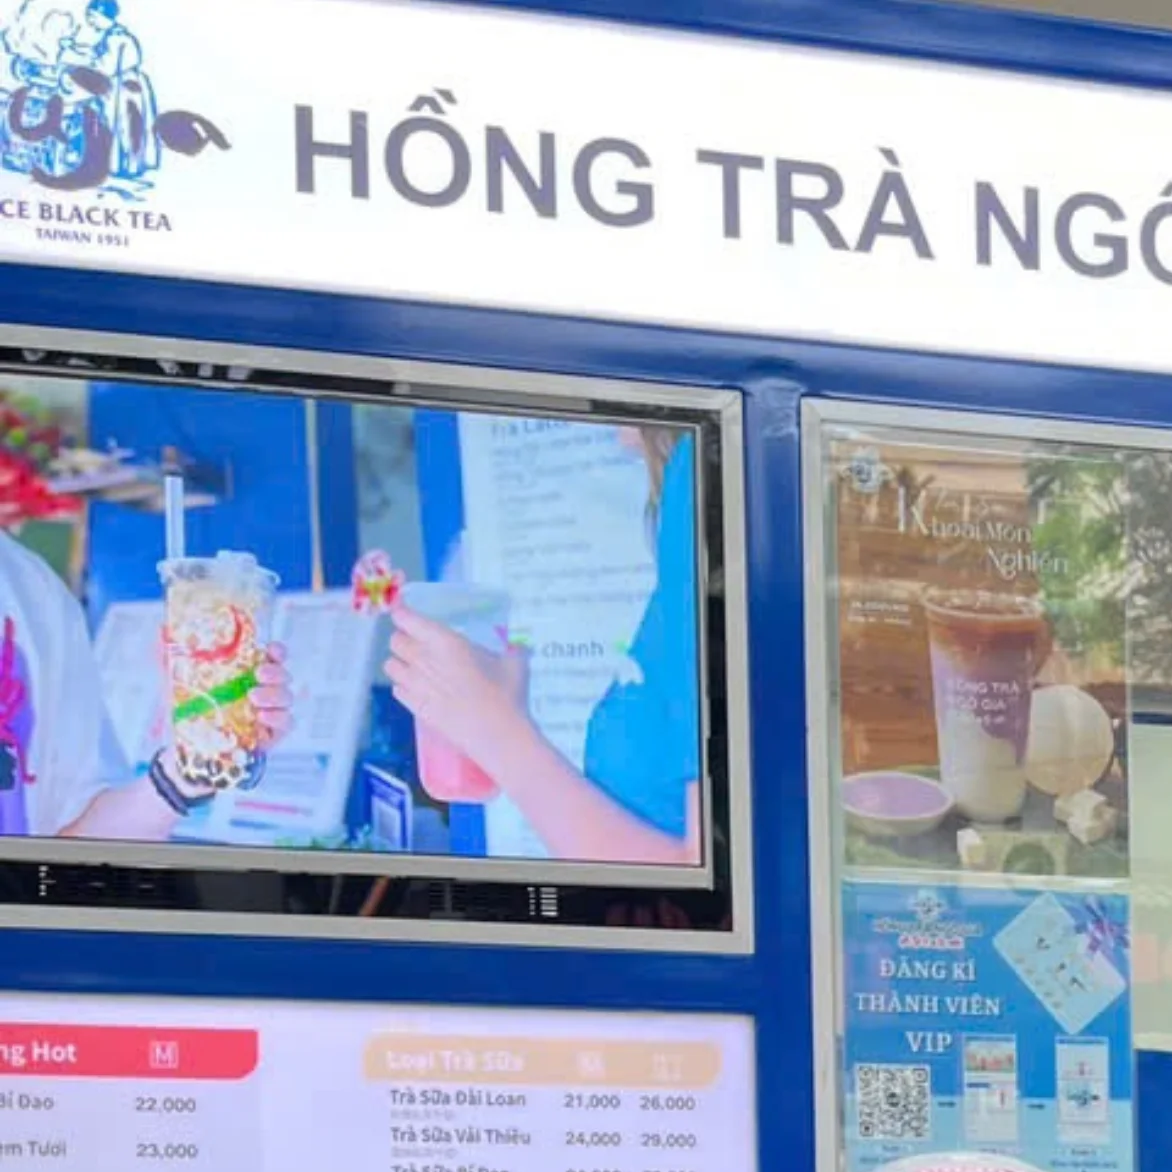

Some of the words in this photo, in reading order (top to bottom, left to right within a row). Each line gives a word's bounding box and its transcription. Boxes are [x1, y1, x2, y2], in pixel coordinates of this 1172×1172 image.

[4, 66, 232, 191] ujia
[294, 88, 655, 227] HỒNG
[695, 146, 935, 261] TRÀ
[0, 200, 30, 219] CE
[38, 202, 120, 227] BLACK
[127, 210, 173, 231] TEA
[35, 227, 92, 243] TAIWAN
[97, 234, 131, 247] 1951
[856, 991, 938, 1014] THÀNH
[944, 995, 1000, 1016] VIÊN
[32, 1042, 77, 1063] Hot
[906, 1031, 952, 1053] VIP
[135, 1097, 197, 1113] 22,000
[486, 1092, 526, 1106] Loan
[564, 1094, 621, 1111] 21,000
[566, 1132, 622, 1149] 24,000
[641, 1134, 697, 1150] 29,000
[136, 1144, 199, 1161] 23,000
